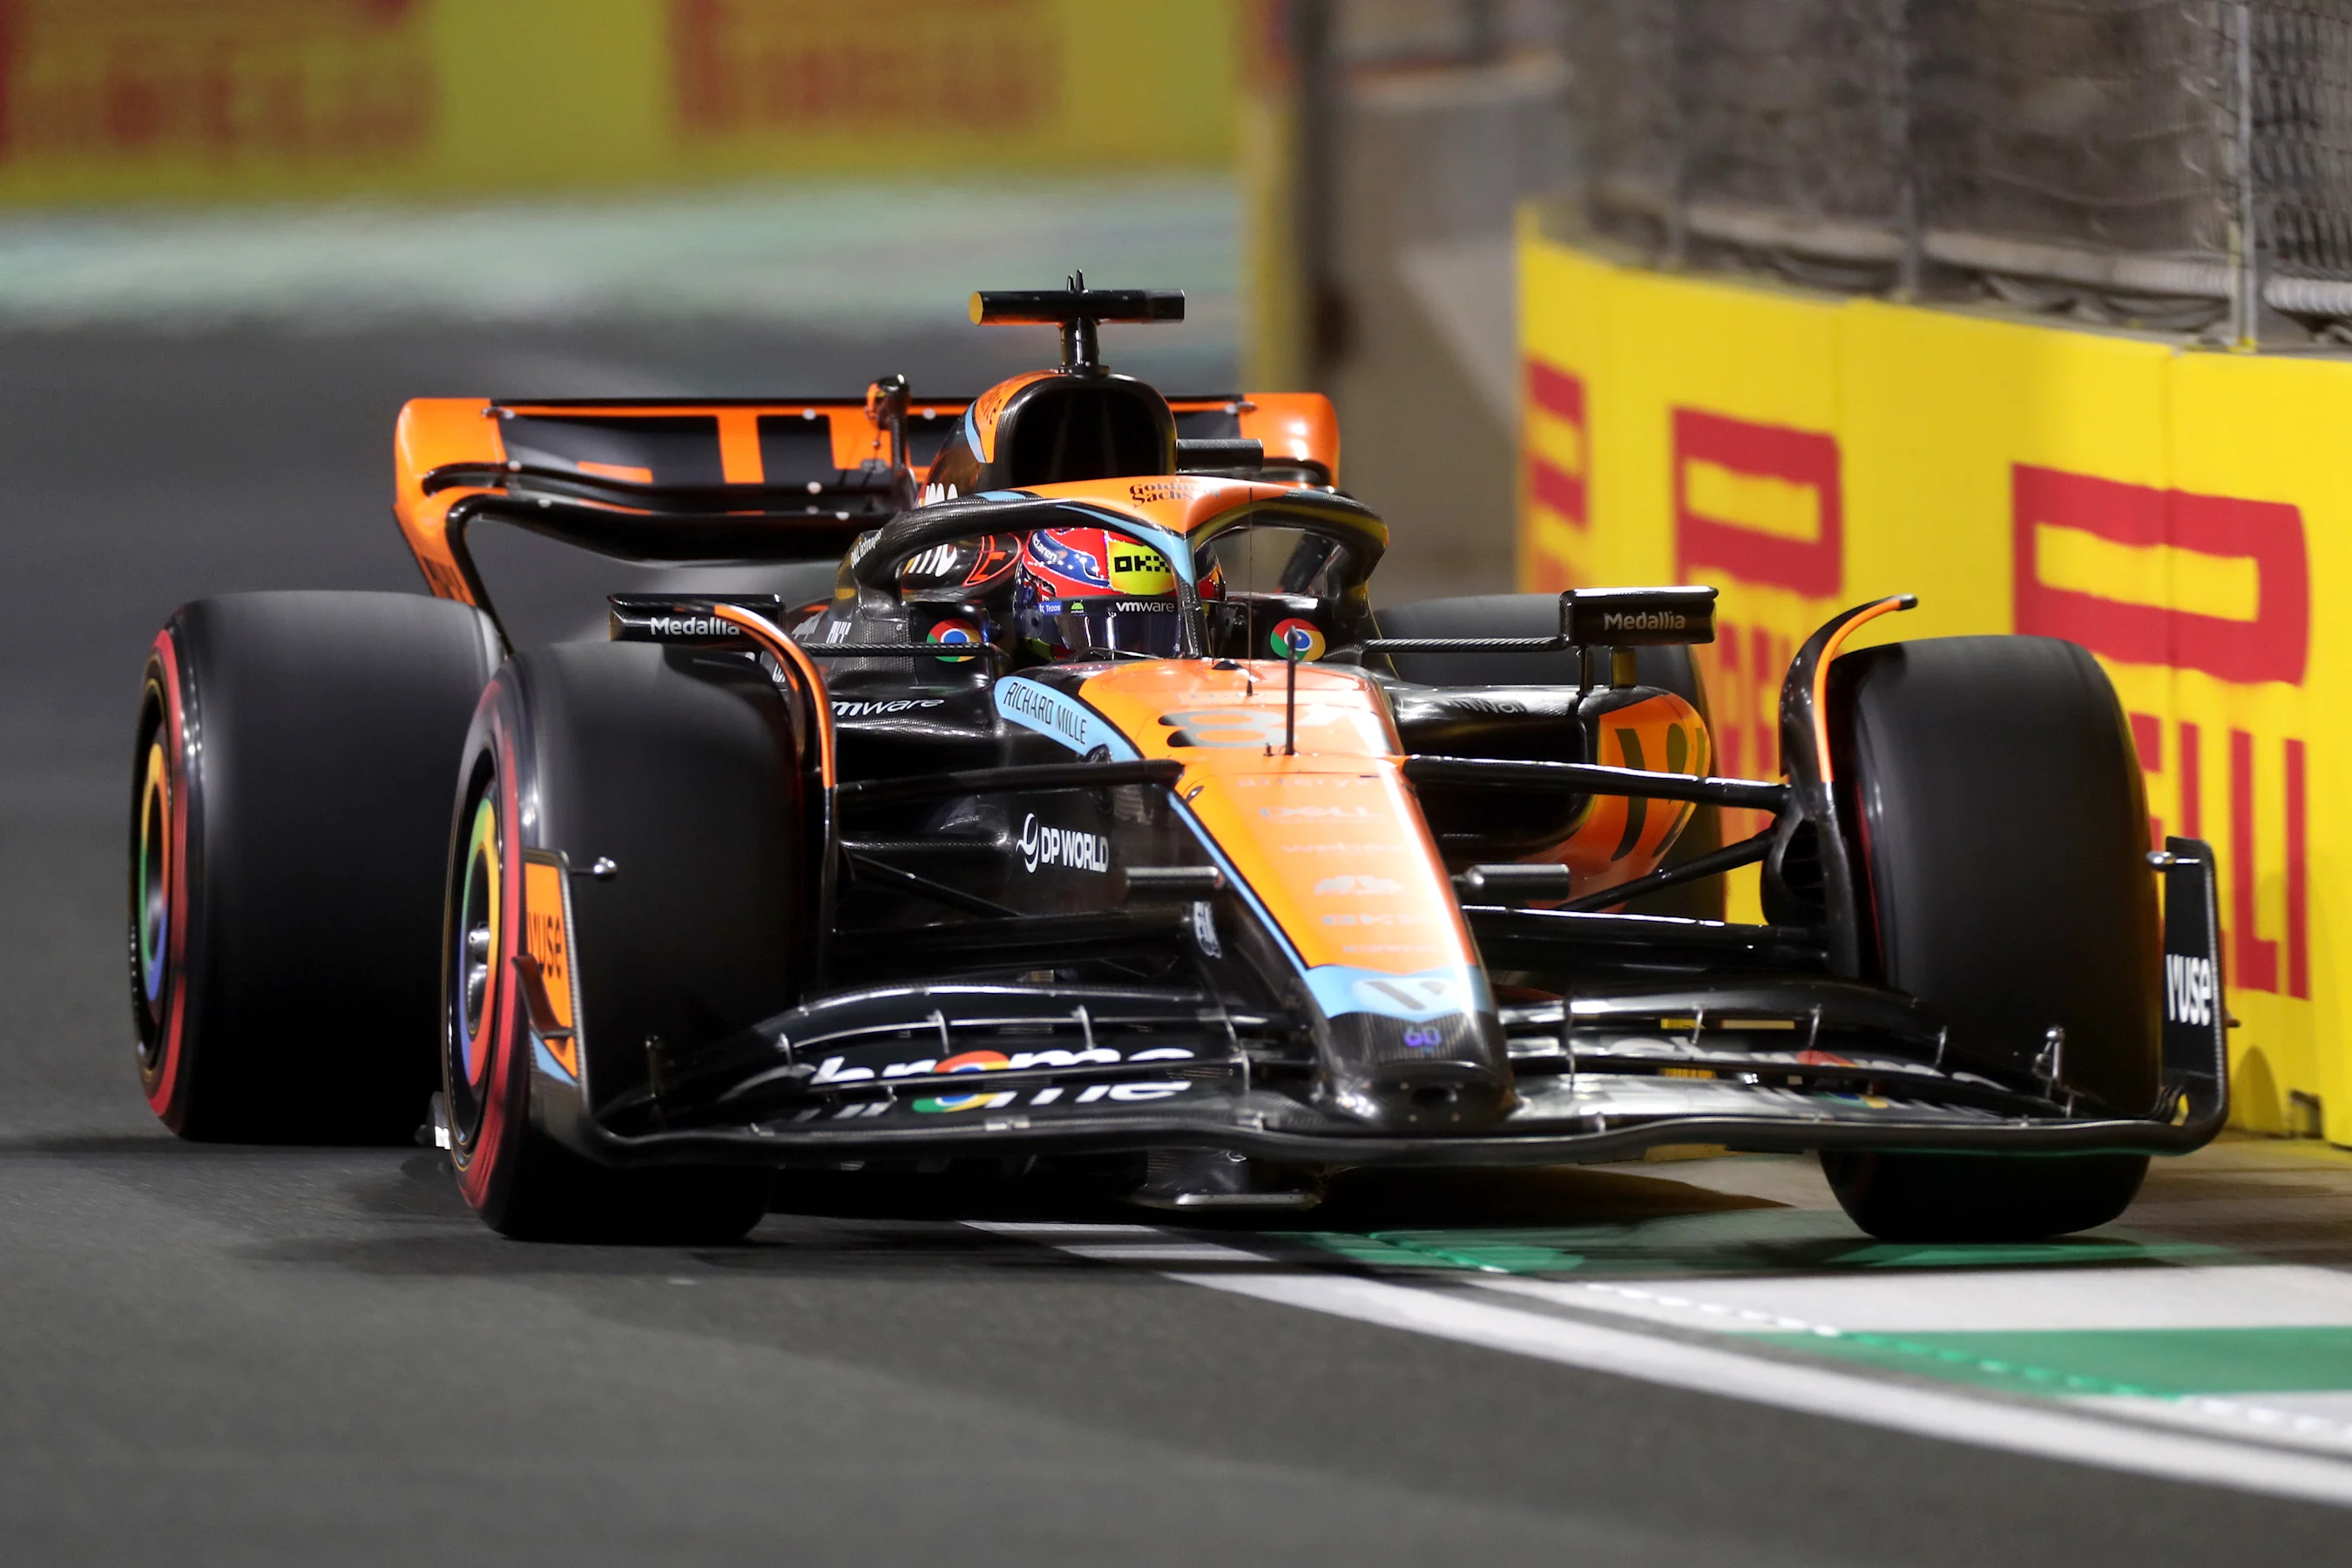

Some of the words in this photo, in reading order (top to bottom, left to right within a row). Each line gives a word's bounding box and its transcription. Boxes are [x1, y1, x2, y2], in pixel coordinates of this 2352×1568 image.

[1114, 555, 1171, 573] OKX
[1116, 601, 1175, 613] vmware
[651, 616, 740, 636] Medallia
[1603, 611, 1686, 631] Medallia
[831, 700, 945, 716] mware
[1004, 682, 1054, 726] RICHARD
[1056, 704, 1087, 746] MILLE
[1041, 827, 1060, 865] DP
[1061, 829, 1110, 873] WORLD
